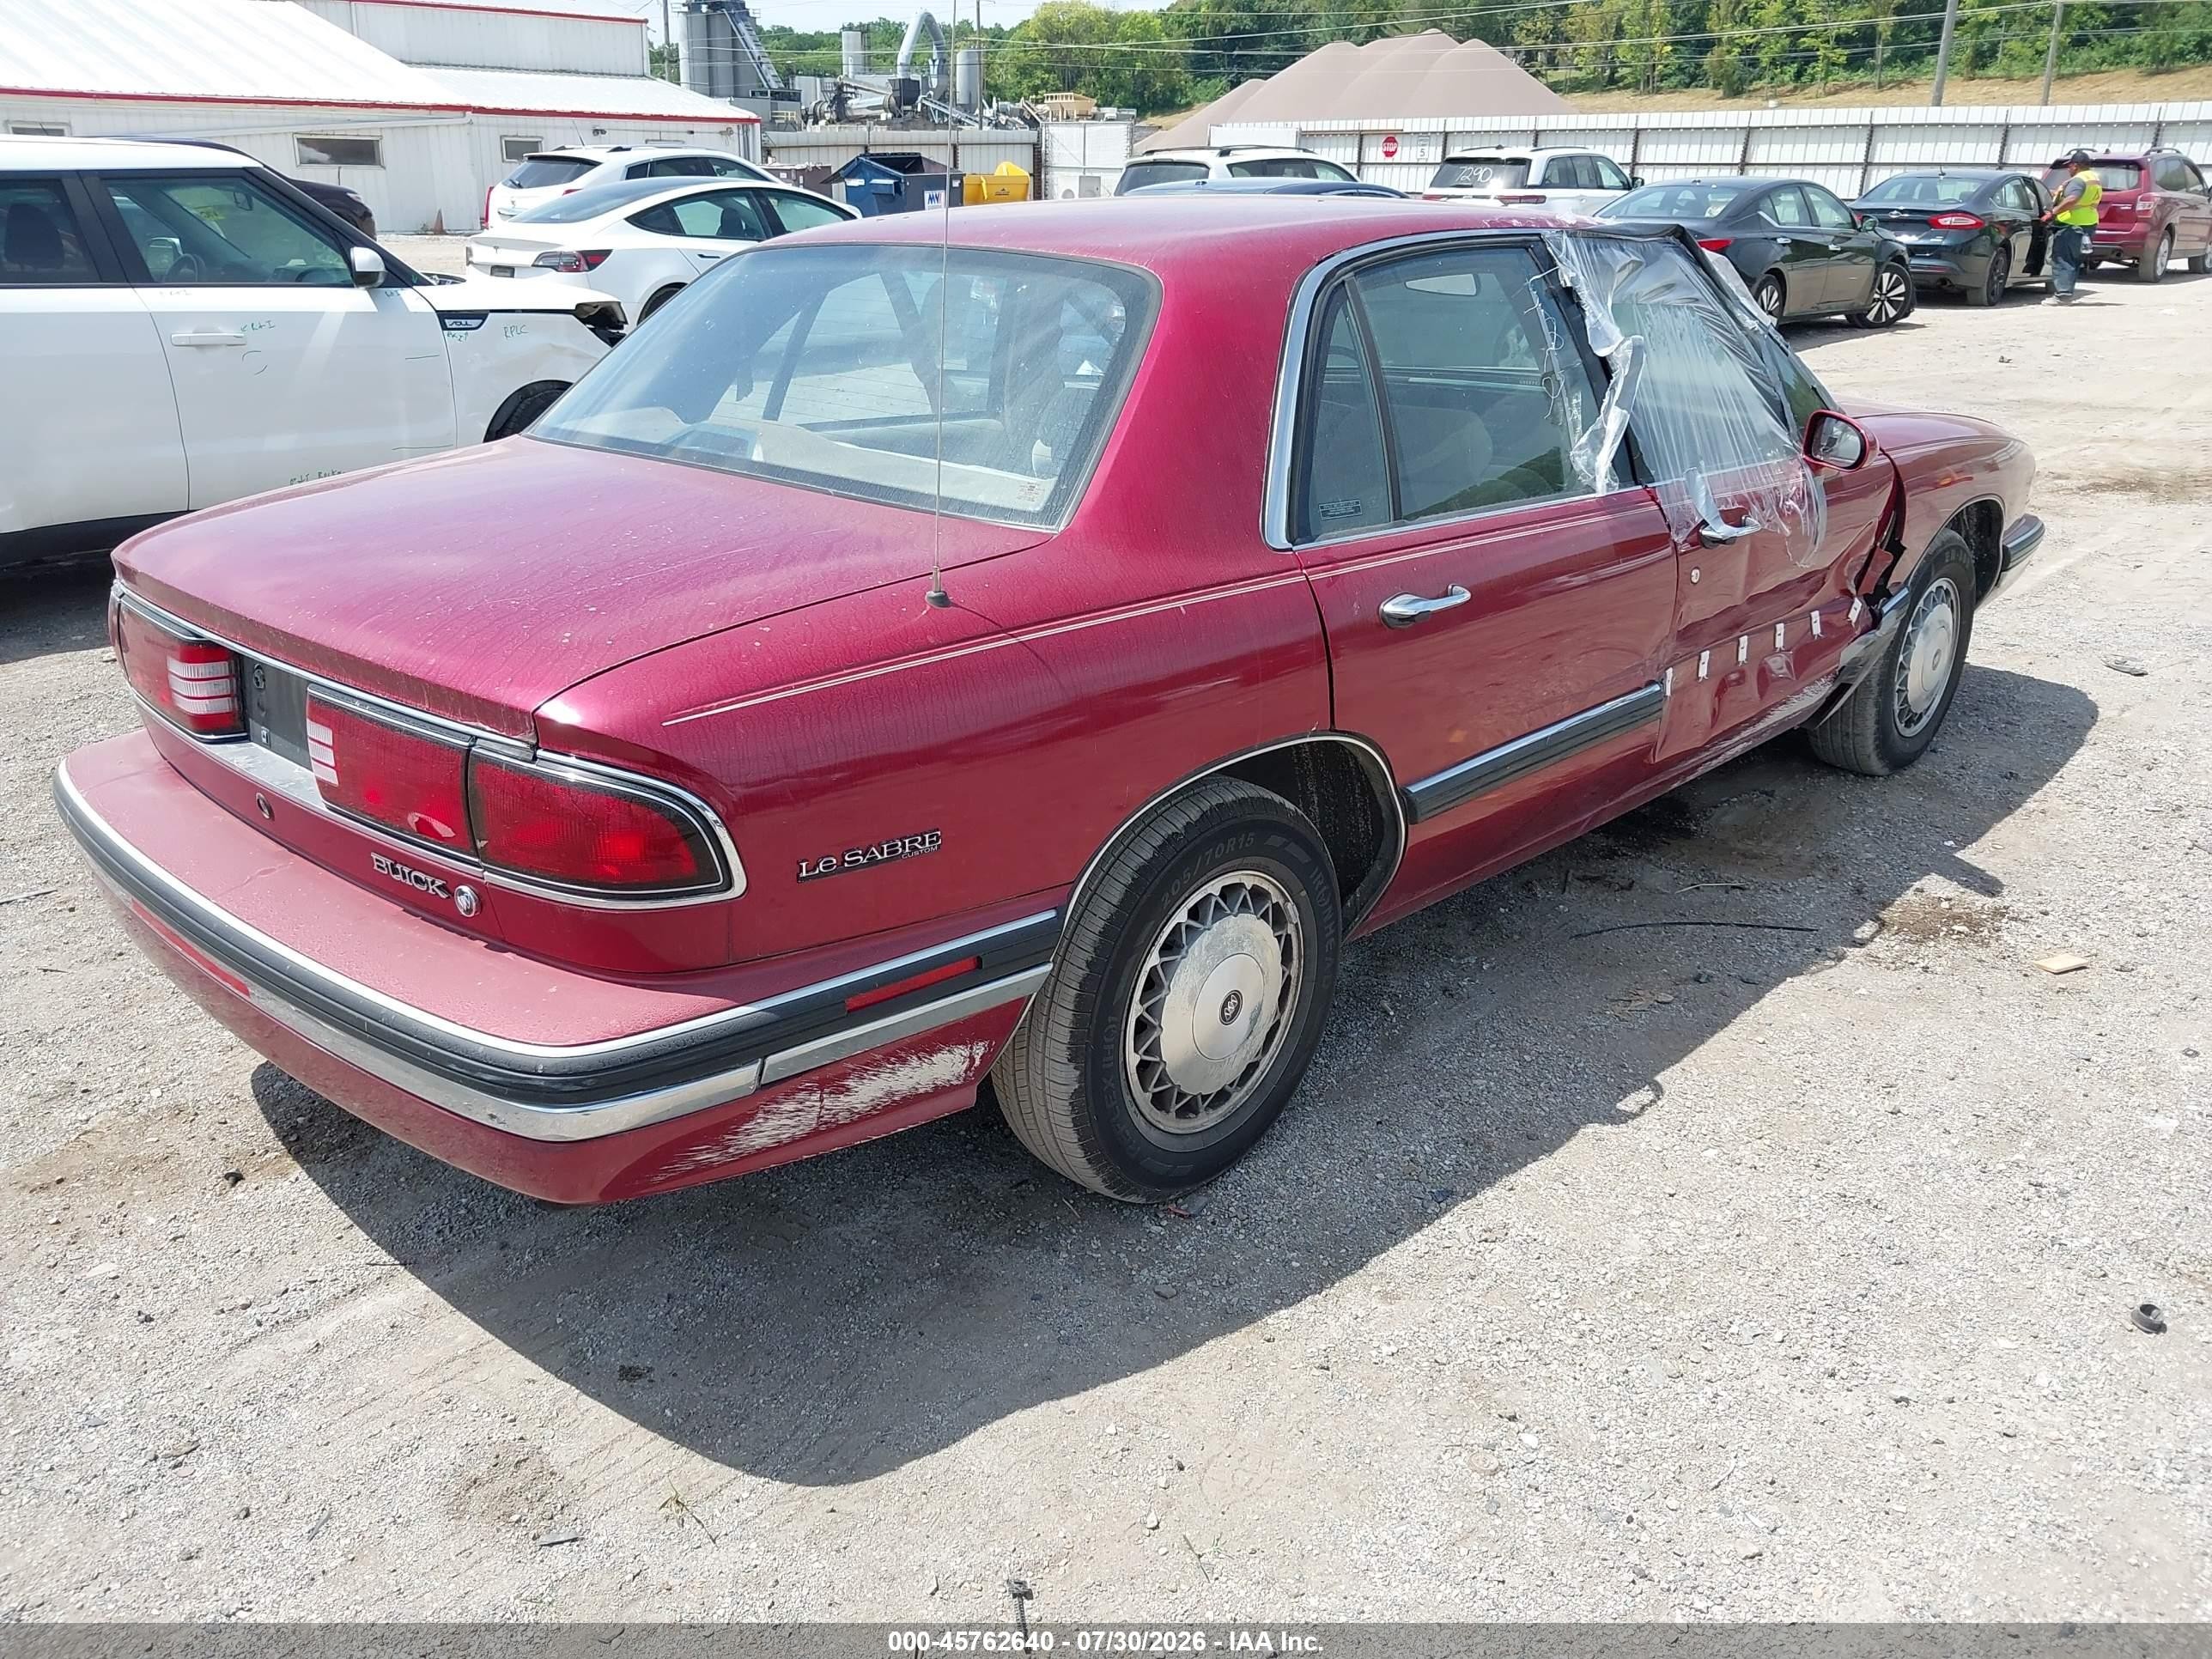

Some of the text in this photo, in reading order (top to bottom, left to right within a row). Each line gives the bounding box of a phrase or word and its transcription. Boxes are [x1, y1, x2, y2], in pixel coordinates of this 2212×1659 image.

[1382, 142, 1398, 153] STOP
[1419, 148, 1425, 157] 5
[1455, 166, 1493, 183] 7290
[902, 845, 939, 860] CUSTOM
[370, 852, 450, 899] BUICK
[1160, 830, 1256, 910] 205/70R15
